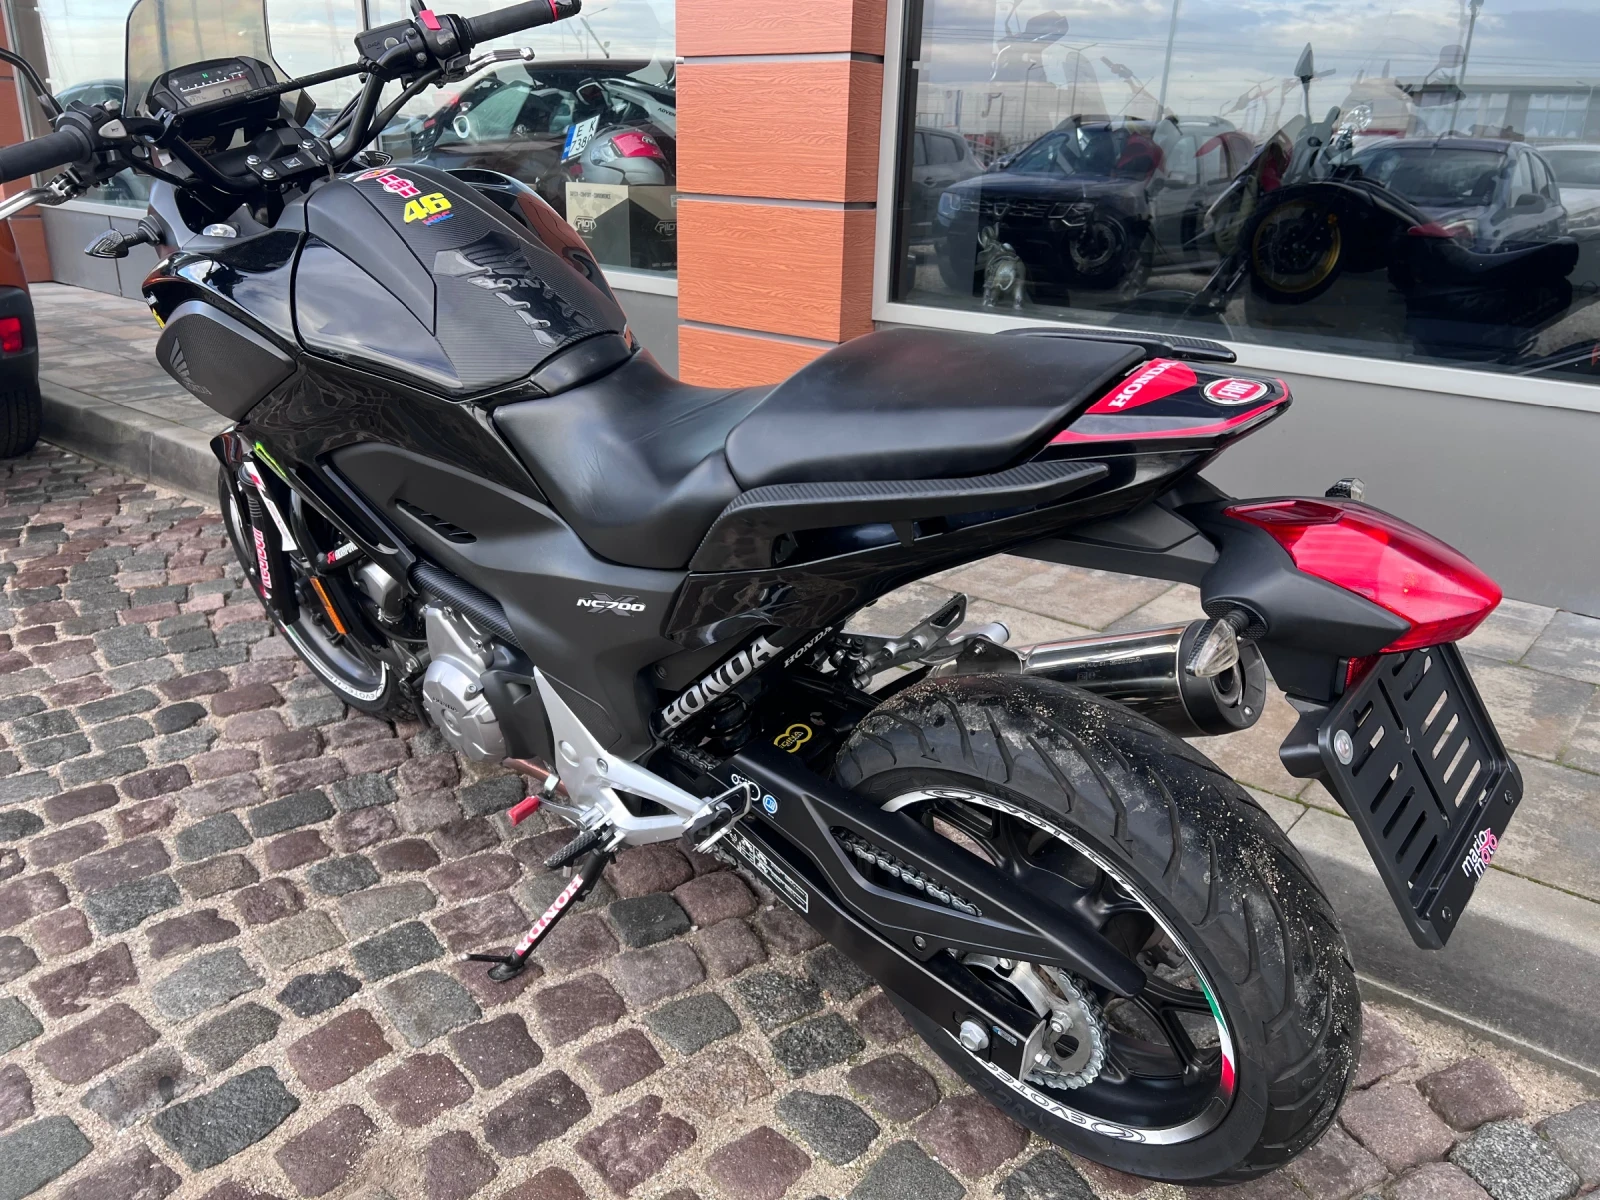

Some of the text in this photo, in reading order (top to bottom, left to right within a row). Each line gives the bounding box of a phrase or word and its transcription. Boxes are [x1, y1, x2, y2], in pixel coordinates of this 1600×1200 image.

[403, 192, 452, 224] 46
[1108, 361, 1179, 408] HONDA
[1216, 380, 1255, 399] FIAT
[576, 598, 647, 612] NC700
[783, 626, 834, 669] HONDA
[661, 635, 784, 729] HONDA
[1462, 830, 1487, 878] mario
[514, 874, 584, 955] HONDA
